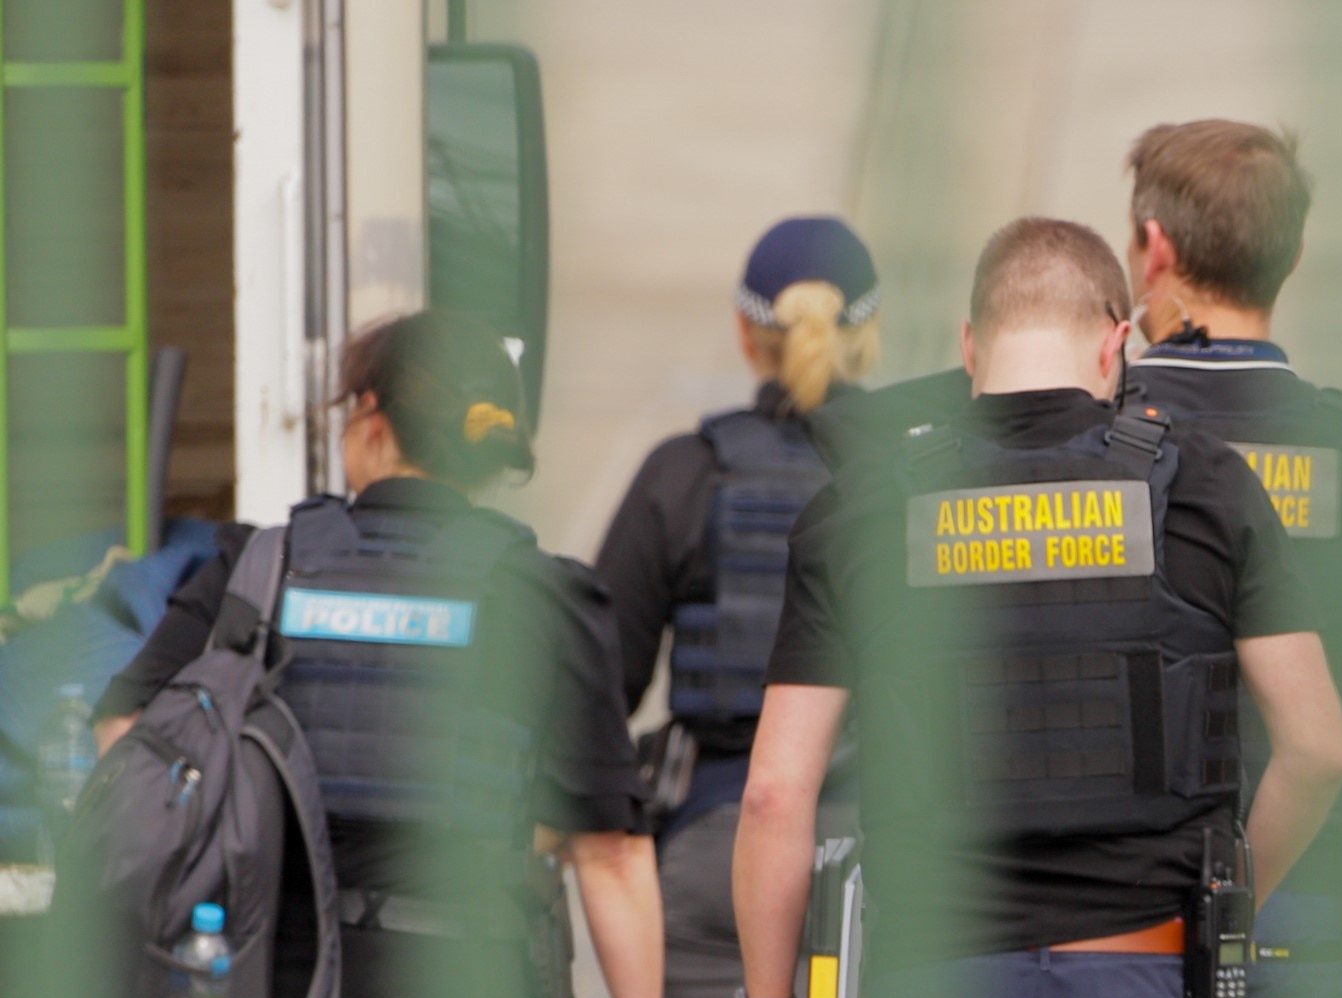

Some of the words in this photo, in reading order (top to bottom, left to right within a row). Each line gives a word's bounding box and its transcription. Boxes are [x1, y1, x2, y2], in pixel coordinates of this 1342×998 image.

[936, 490, 1125, 537] AUSTRALIAN
[936, 537, 1033, 575] BORDER
[1045, 533, 1128, 569] FORCE
[303, 605, 450, 639] POLICE
